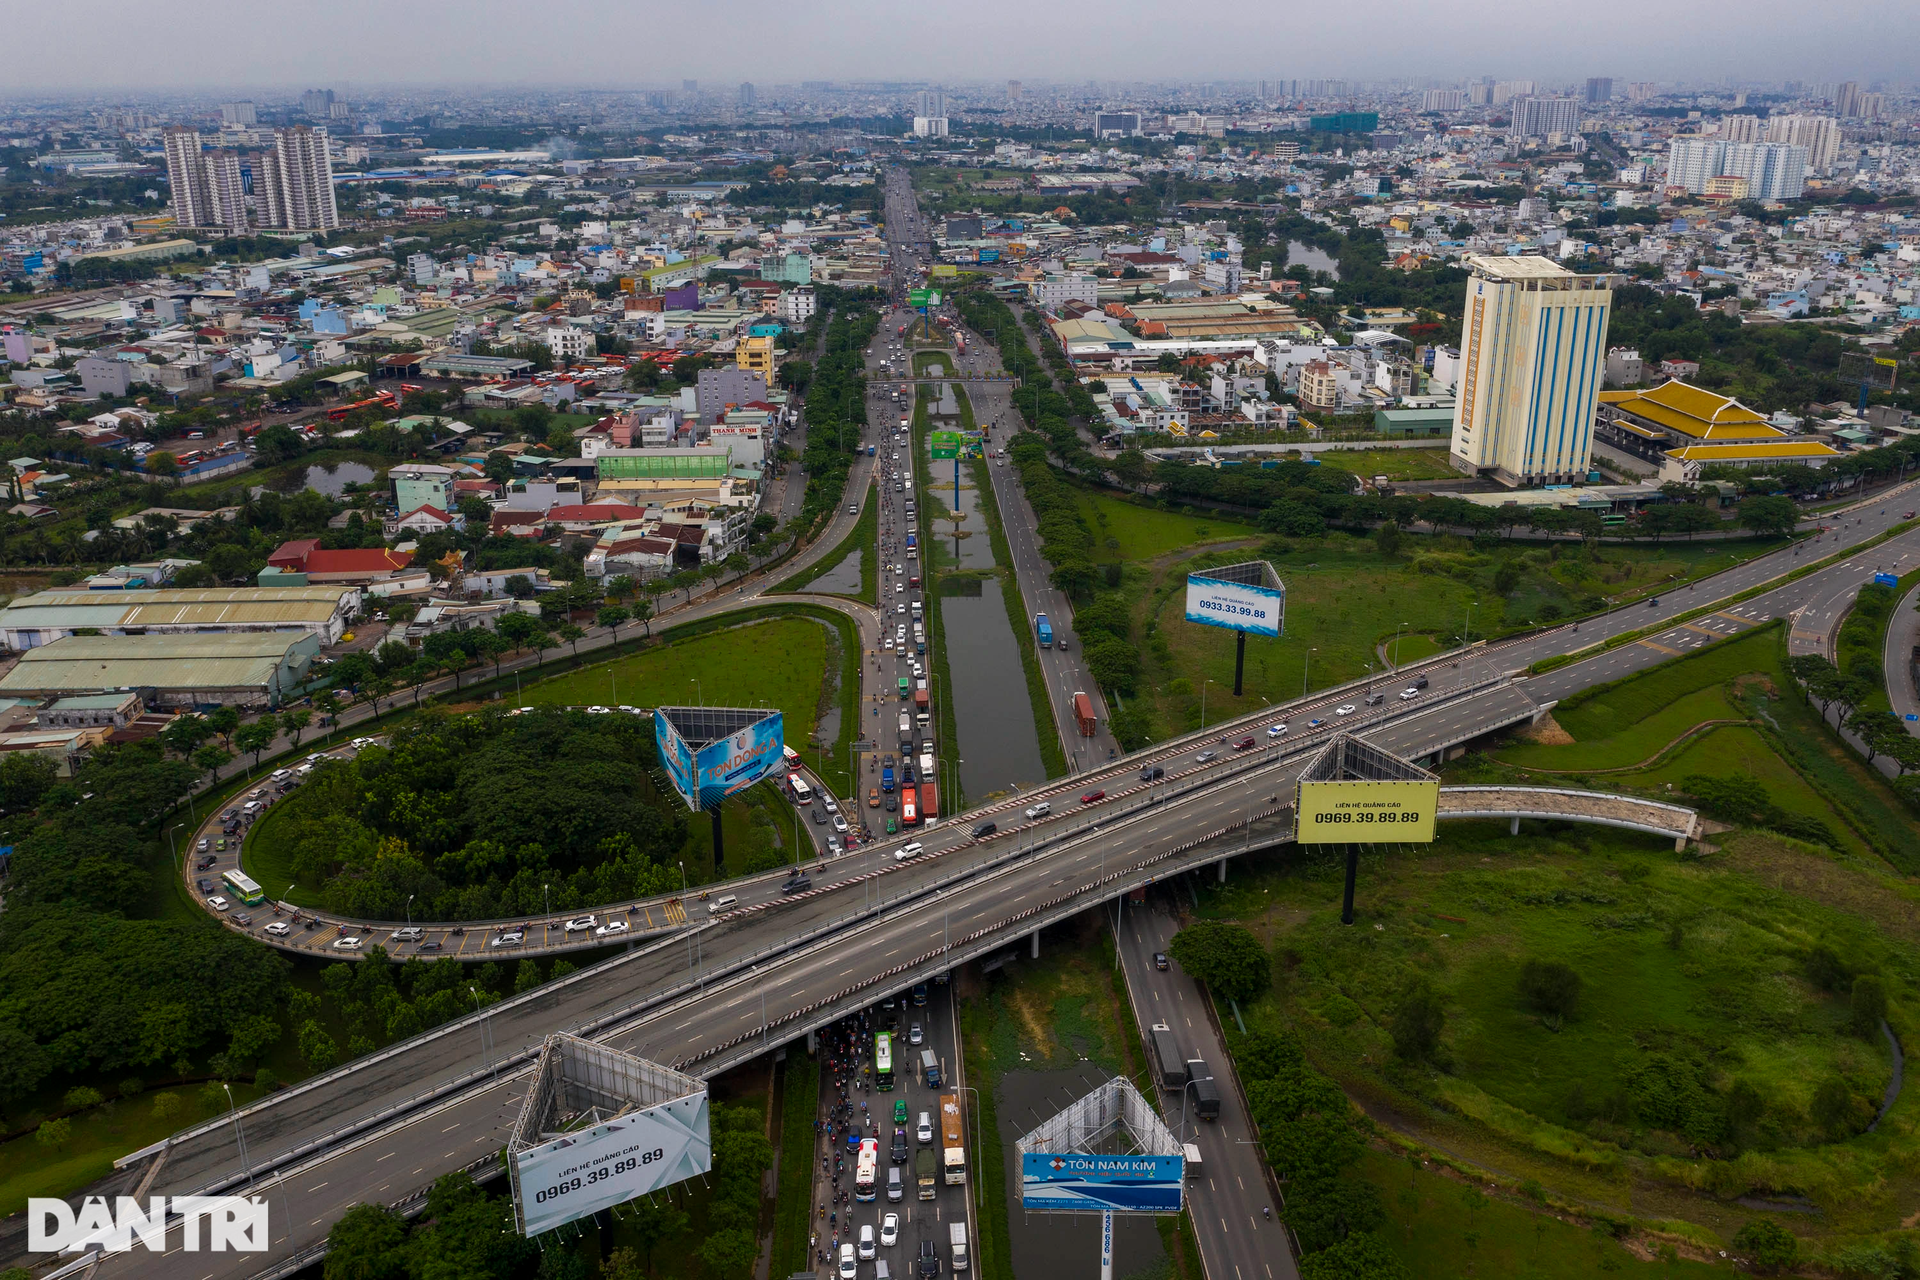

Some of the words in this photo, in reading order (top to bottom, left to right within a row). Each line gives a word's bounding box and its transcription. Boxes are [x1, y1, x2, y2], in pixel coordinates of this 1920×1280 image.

[1199, 600, 1266, 619] 0933.33.99.88
[1315, 812, 1420, 824] 0969.39.89.89
[558, 1166, 578, 1178] LIÊN
[579, 1161, 591, 1171] HỆ
[592, 1151, 622, 1166] QUẢNG
[622, 1144, 640, 1156] CÁO
[1068, 1158, 1095, 1170] TÔN
[1098, 1161, 1129, 1171] NAM
[1132, 1161, 1156, 1171] KIM
[535, 1148, 664, 1204] 0969.39.89.89
